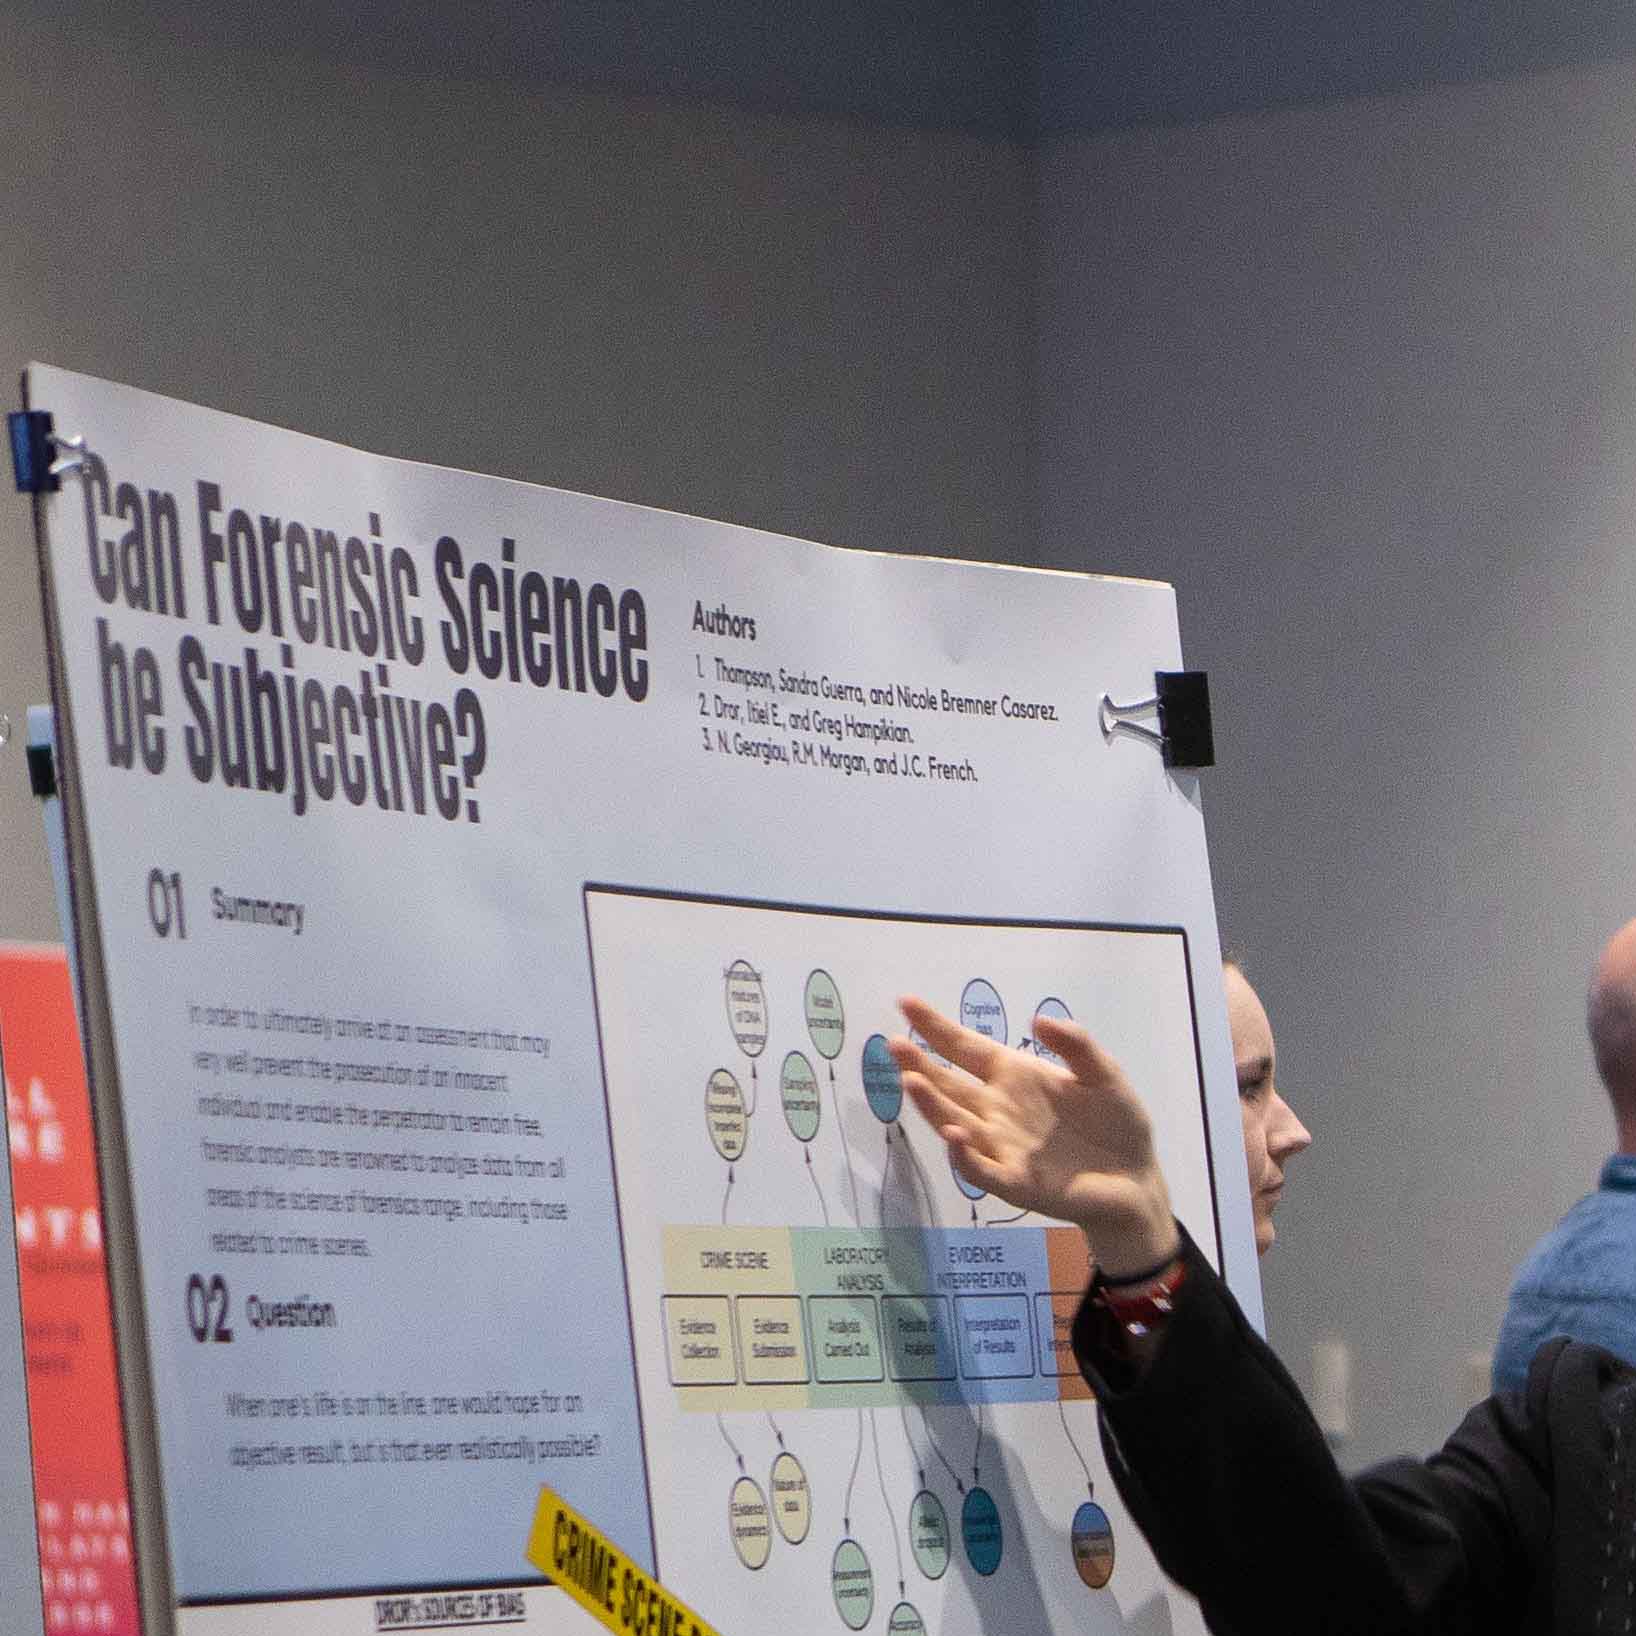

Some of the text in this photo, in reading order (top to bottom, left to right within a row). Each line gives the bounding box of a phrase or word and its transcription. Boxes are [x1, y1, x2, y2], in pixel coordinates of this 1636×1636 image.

[82, 451, 649, 702] Can Forensic Science
[692, 600, 756, 641] Authors
[97, 616, 487, 823] be Subjective?
[714, 657, 773, 693] Thompson,
[778, 668, 818, 697] Sandra
[820, 675, 864, 706] Guerra,
[869, 684, 893, 706] and
[896, 685, 937, 711] Nicole
[941, 689, 997, 716] Bremner
[1001, 694, 1059, 721] Casarez.
[714, 694, 744, 723] Dror,
[788, 709, 810, 731] and
[812, 710, 842, 741] Greg
[844, 715, 914, 744] Hampikian.
[717, 730, 731, 754] N.
[792, 740, 817, 766] R.M.
[820, 745, 870, 776] Morgan,
[873, 752, 896, 775] and
[900, 754, 925, 778] J.C.
[928, 756, 978, 782] French.
[147, 867, 305, 939] 01 Summary
[949, 1246, 1005, 1264] EVIDENCE
[186, 1272, 336, 1343] 02 Question
[552, 1509, 618, 1614] CRIME
